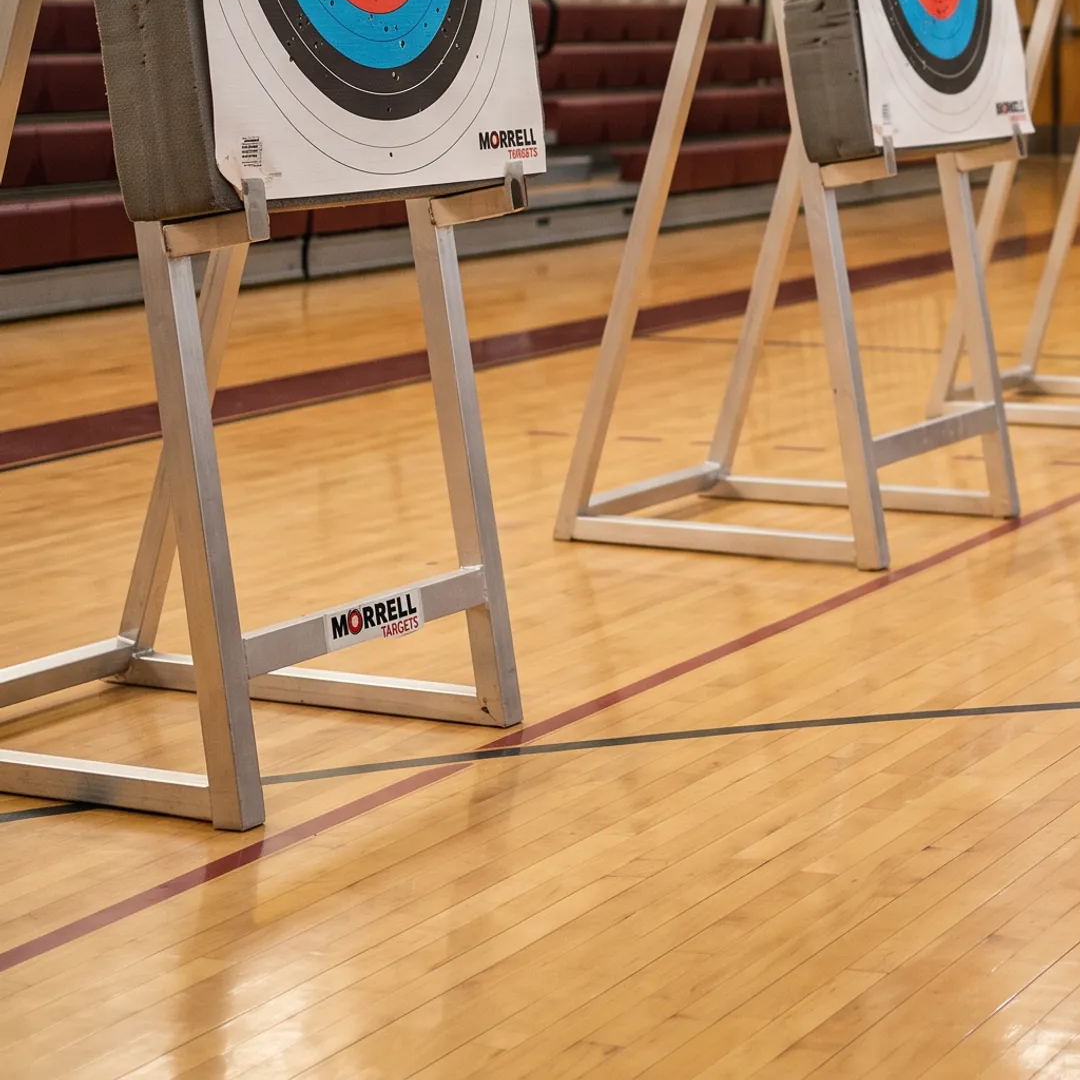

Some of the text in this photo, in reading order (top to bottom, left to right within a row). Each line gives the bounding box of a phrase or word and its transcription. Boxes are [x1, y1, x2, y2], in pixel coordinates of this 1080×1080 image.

[479, 128, 537, 150] MORRELL
[331, 594, 417, 639] MORRELL
[381, 616, 419, 638] TARGETS
